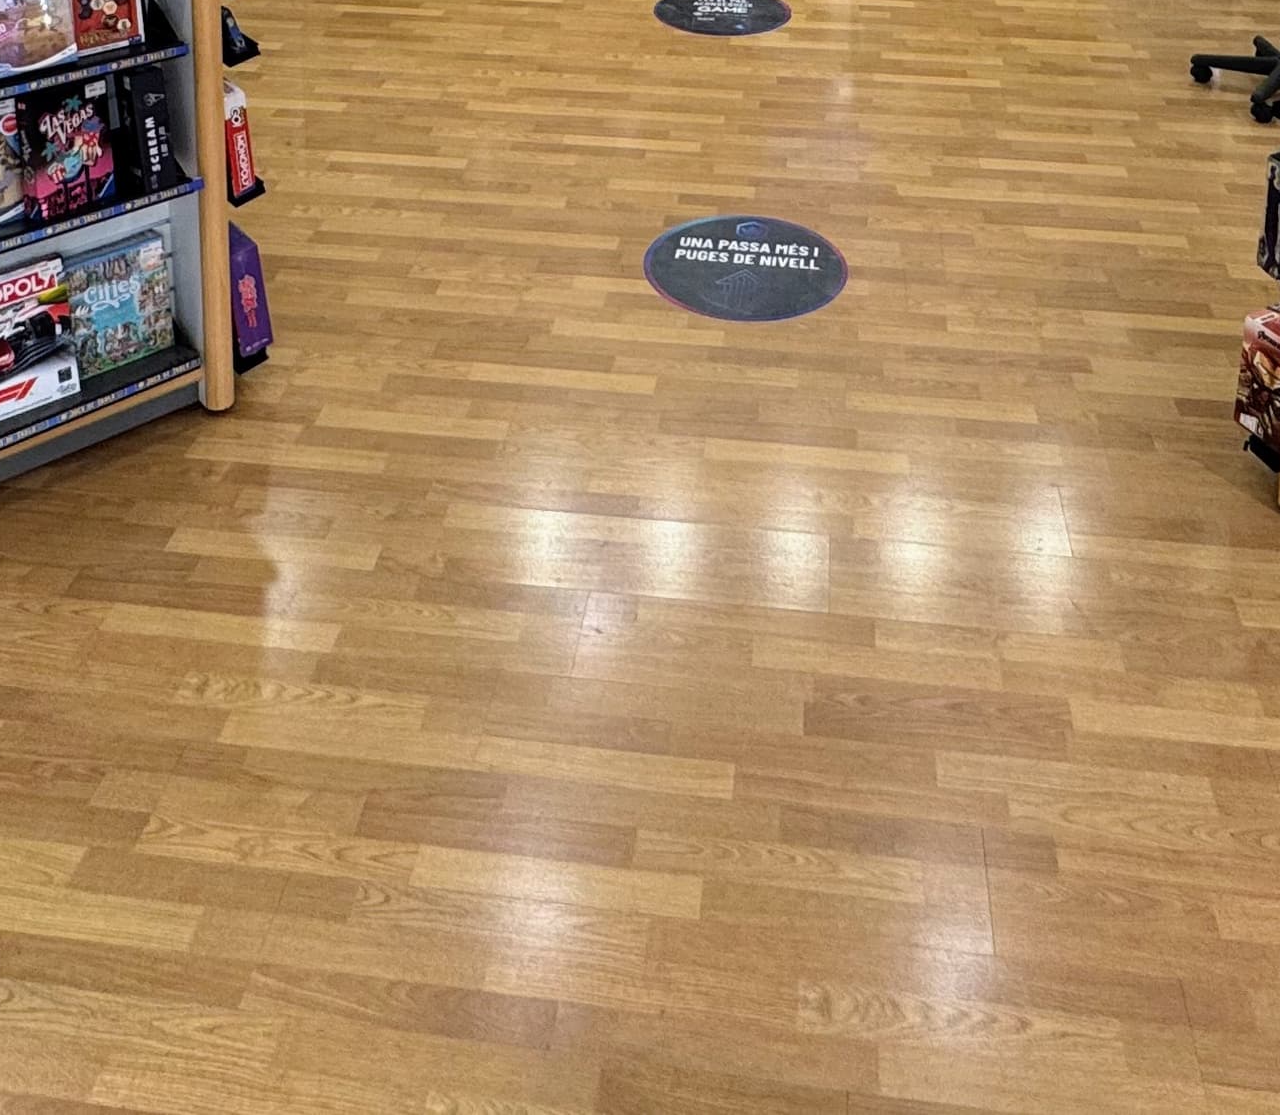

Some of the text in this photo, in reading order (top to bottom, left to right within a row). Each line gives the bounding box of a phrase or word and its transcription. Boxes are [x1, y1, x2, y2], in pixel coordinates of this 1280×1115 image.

[38, 108, 67, 137] LAS
[56, 103, 95, 144] VEGAS
[144, 116, 162, 172] SCREAM
[233, 131, 253, 192] MONOPOLY
[674, 249, 820, 271] PUGES DE NIVELL
[679, 236, 714, 250] UNA
[718, 238, 770, 254] PASSA
[775, 239, 809, 256] MÉS
